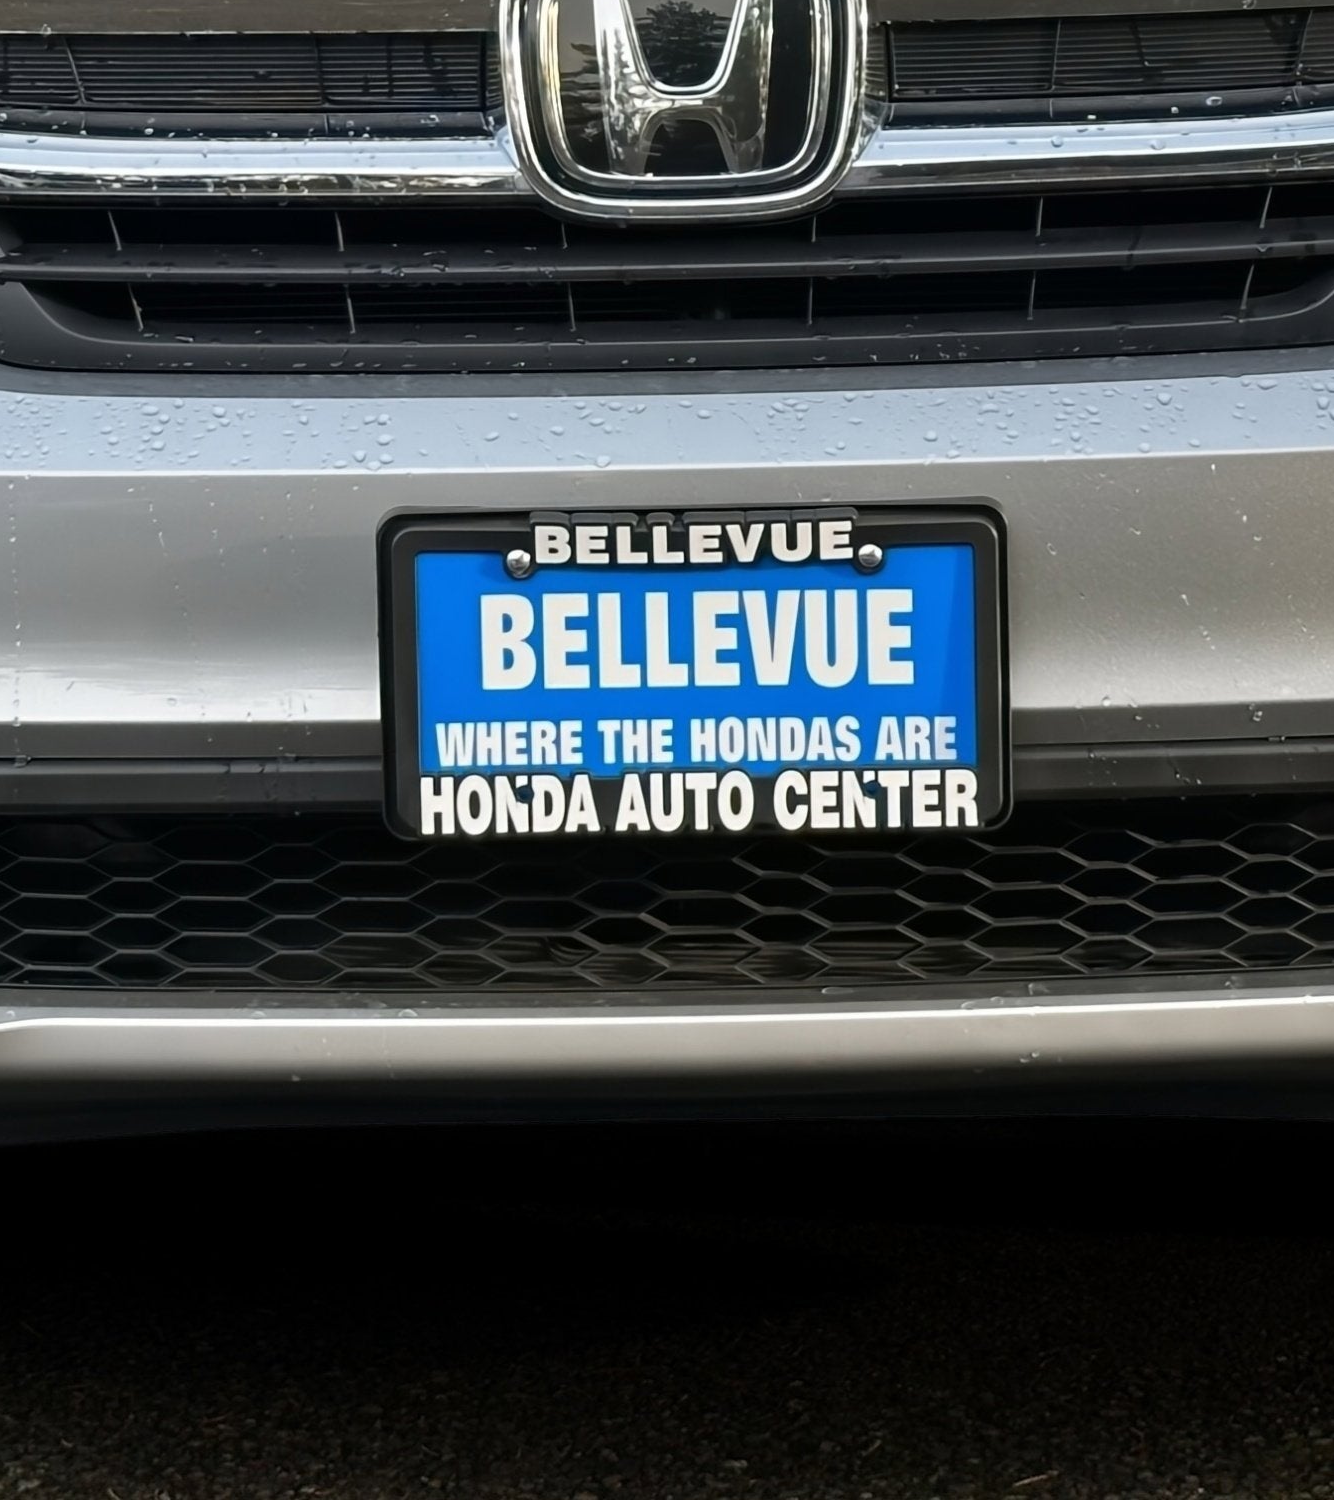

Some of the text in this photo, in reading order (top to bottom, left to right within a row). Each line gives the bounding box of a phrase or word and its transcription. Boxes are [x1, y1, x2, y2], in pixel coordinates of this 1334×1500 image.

[533, 520, 855, 565] BELLEVUE
[480, 588, 915, 690] BELLEVUE
[436, 715, 958, 767] WHERE THE HONDAS ARE
[419, 769, 980, 835] HONDA AUTO CENTER
